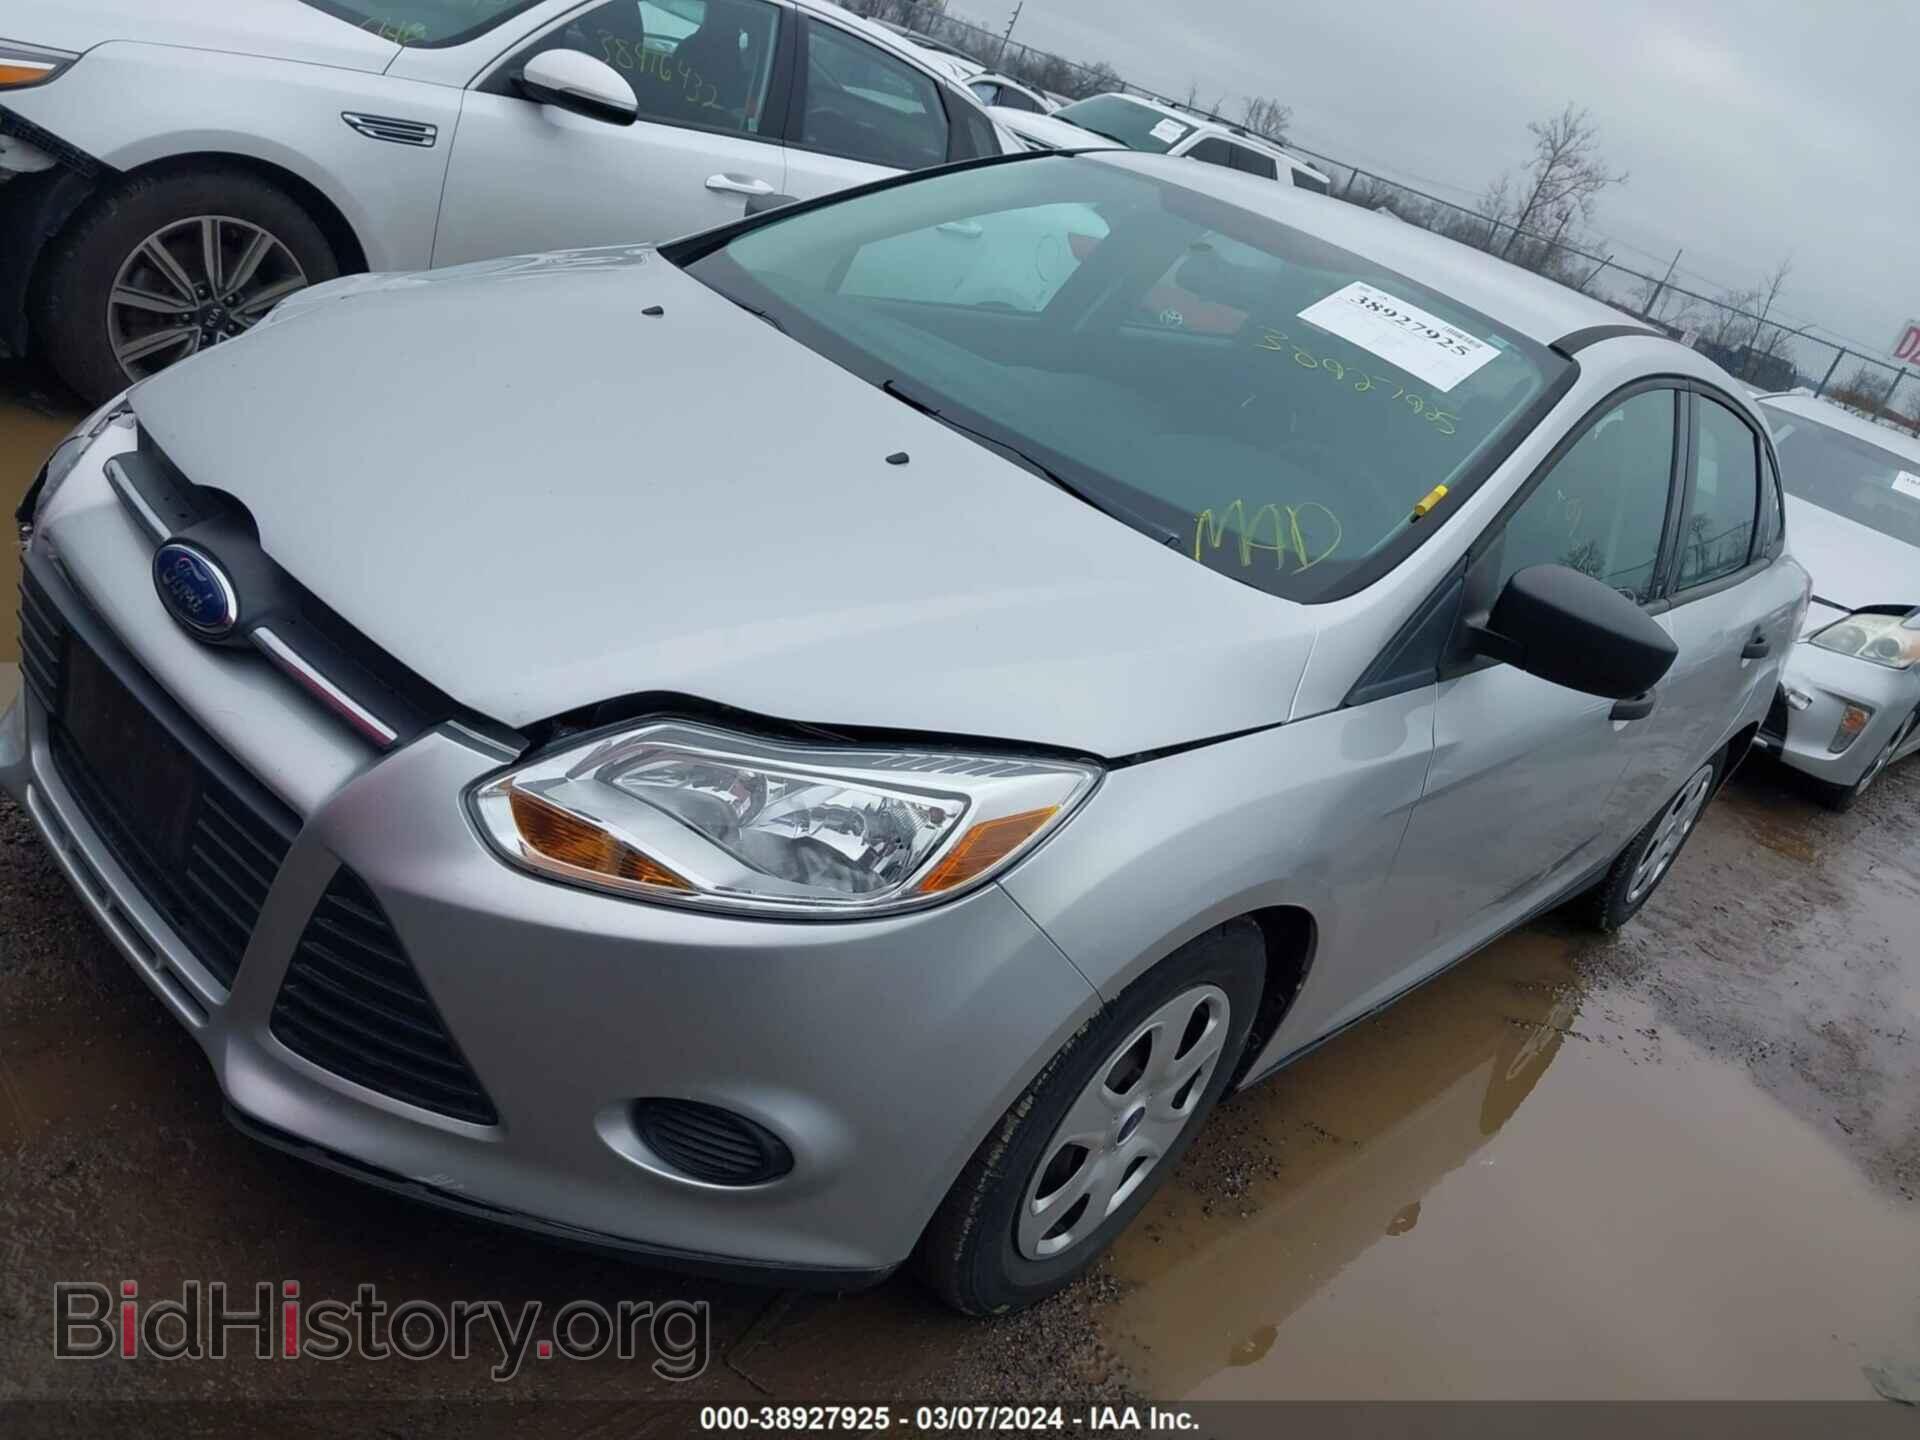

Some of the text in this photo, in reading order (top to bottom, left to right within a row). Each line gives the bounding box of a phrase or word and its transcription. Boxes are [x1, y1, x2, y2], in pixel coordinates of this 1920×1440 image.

[205, 308, 222, 328] KIA
[1349, 294, 1471, 357] 38927925
[1194, 499, 1342, 575] MAD
